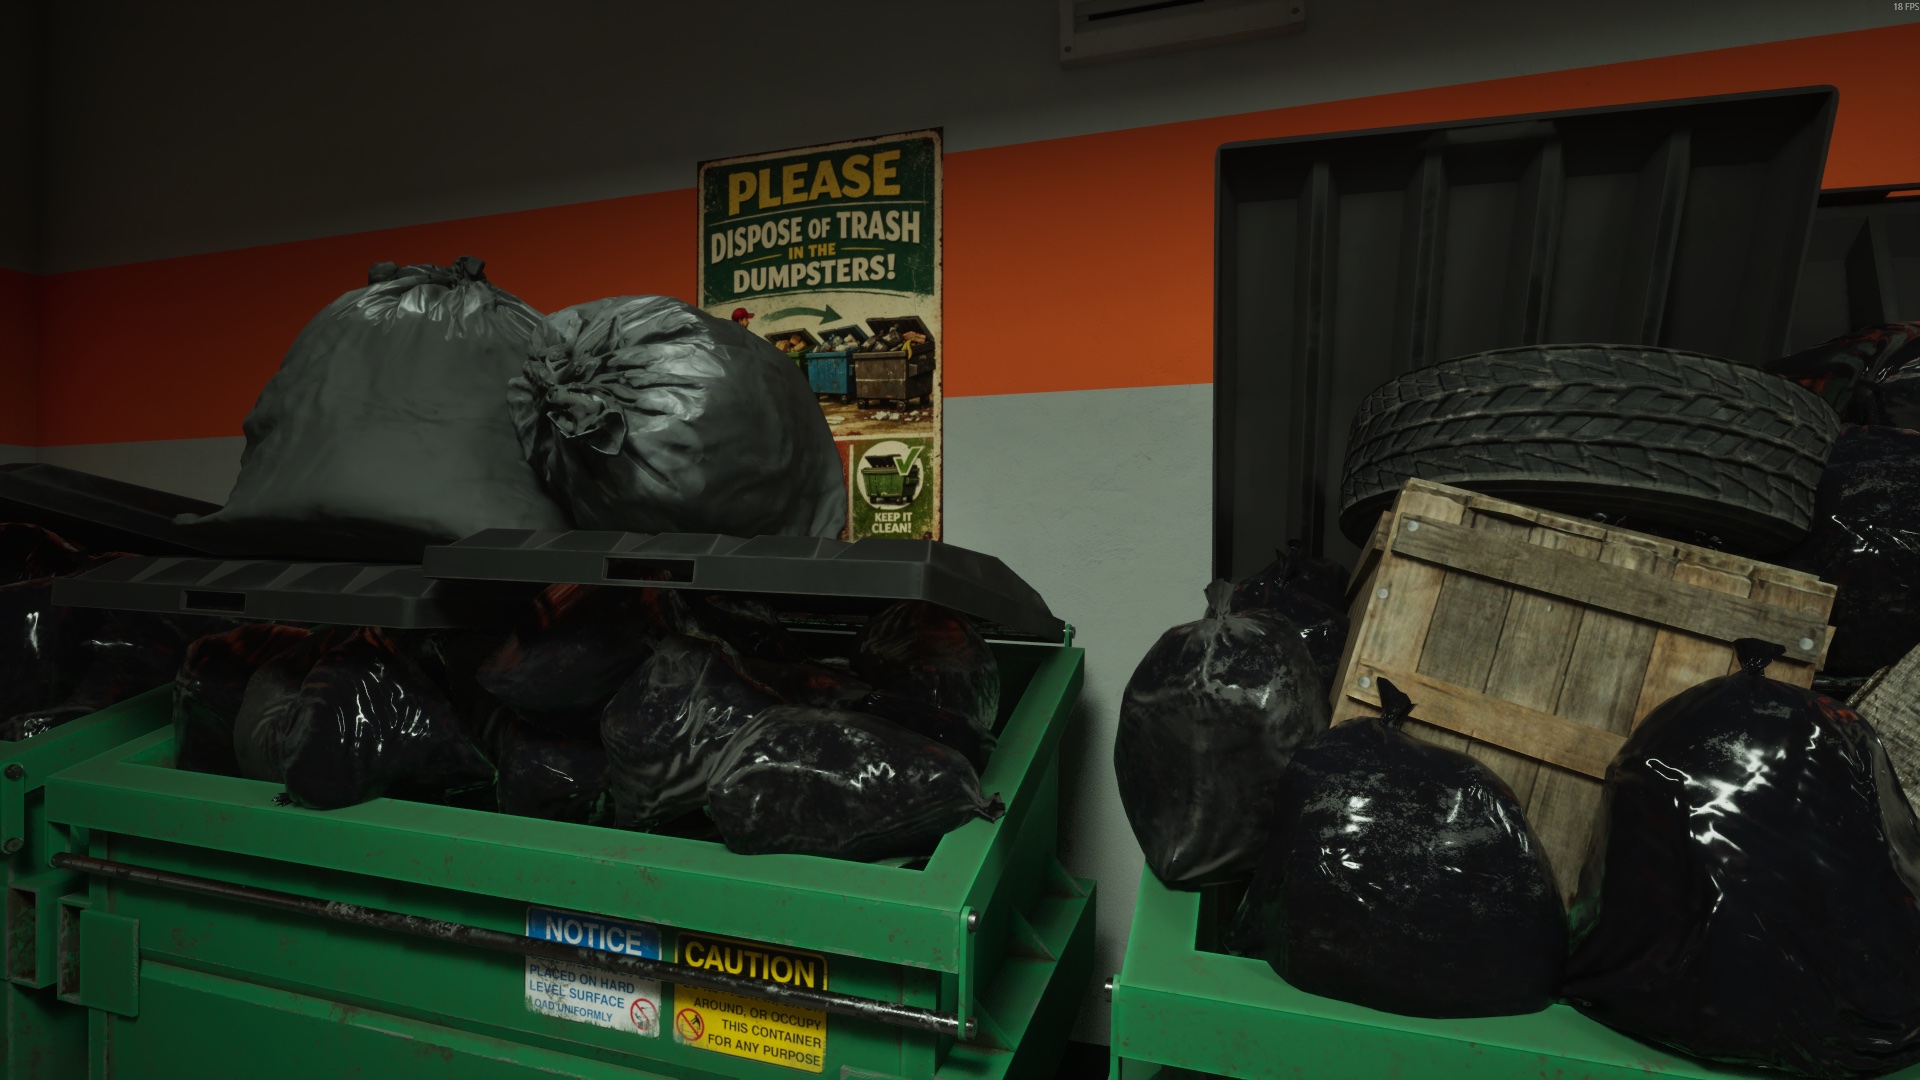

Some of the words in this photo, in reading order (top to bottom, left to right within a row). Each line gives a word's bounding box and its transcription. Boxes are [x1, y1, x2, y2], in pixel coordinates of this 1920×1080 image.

[727, 149, 901, 217] PLEASE
[711, 216, 803, 265] DISPOSE
[808, 217, 831, 240] OF
[836, 210, 921, 244] TRASH
[788, 246, 804, 260] IN
[808, 242, 836, 258] THE
[733, 253, 896, 294] DUMPSTERS!
[871, 522, 912, 534] CLEAN!
[874, 512, 901, 523] KEEP
[902, 512, 913, 522] IT
[545, 915, 642, 957] NOTICE
[529, 964, 576, 983] PLACED
[579, 973, 597, 987] ON
[600, 979, 635, 994] HARD
[684, 940, 815, 989] CAUTION
[529, 980, 566, 997] LEVEL
[569, 988, 625, 1009] SURFACE
[533, 998, 555, 1011] OAD
[557, 1004, 613, 1022] UNIFORMLY
[693, 997, 746, 1018] AROUND,
[749, 1007, 768, 1020] OR
[771, 1012, 822, 1031] OCCUPY
[721, 1018, 748, 1034] THIS
[751, 1025, 822, 1049] CONTAINER
[707, 1033, 733, 1048] FOR
[735, 1039, 761, 1055] ANY
[763, 1045, 821, 1067] PURPOSE
